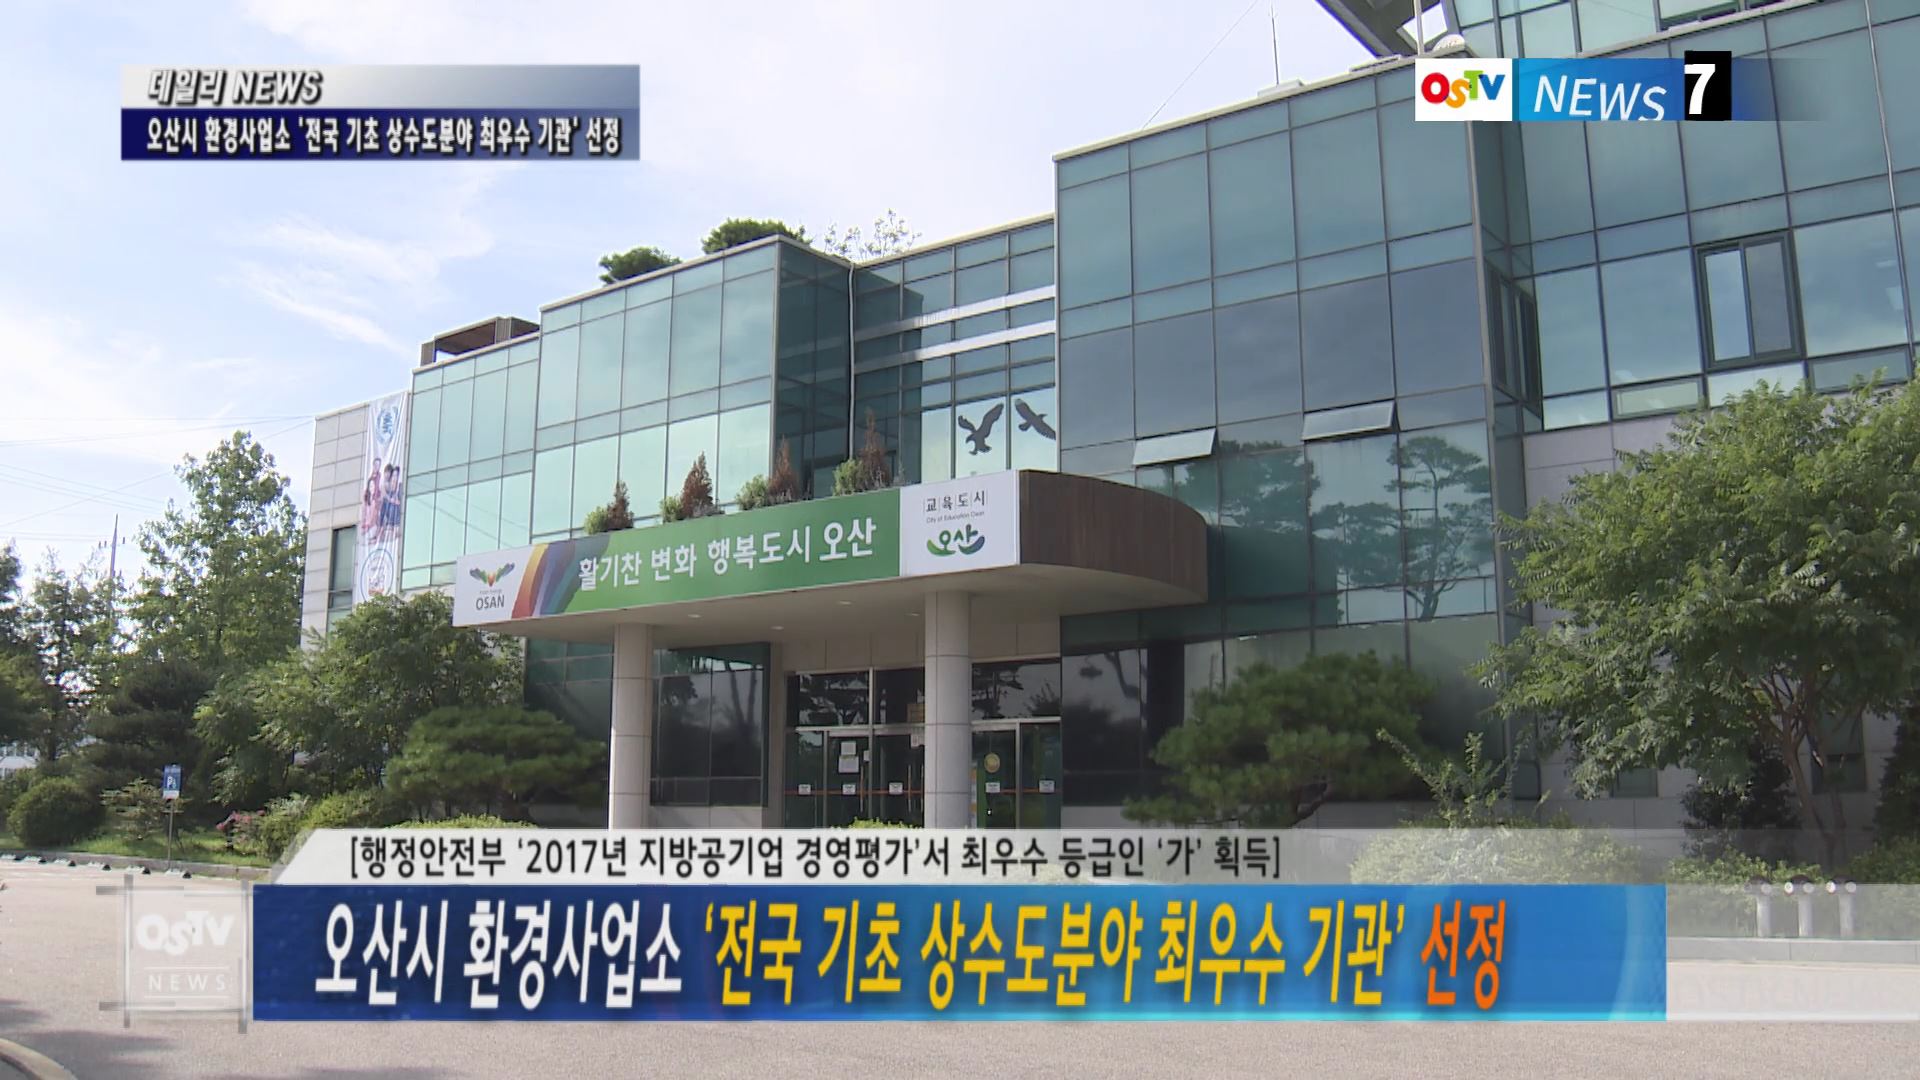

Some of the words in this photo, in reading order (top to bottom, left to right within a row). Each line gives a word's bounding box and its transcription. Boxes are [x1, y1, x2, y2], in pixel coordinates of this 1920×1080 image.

[926, 490, 985, 512] 교육도시
[578, 551, 642, 592] 활기찬
[650, 545, 697, 582] 변화
[708, 525, 812, 577] 행복도시
[822, 515, 877, 563] 오산
[926, 523, 986, 557] 오산
[475, 595, 505, 610] OSAN
